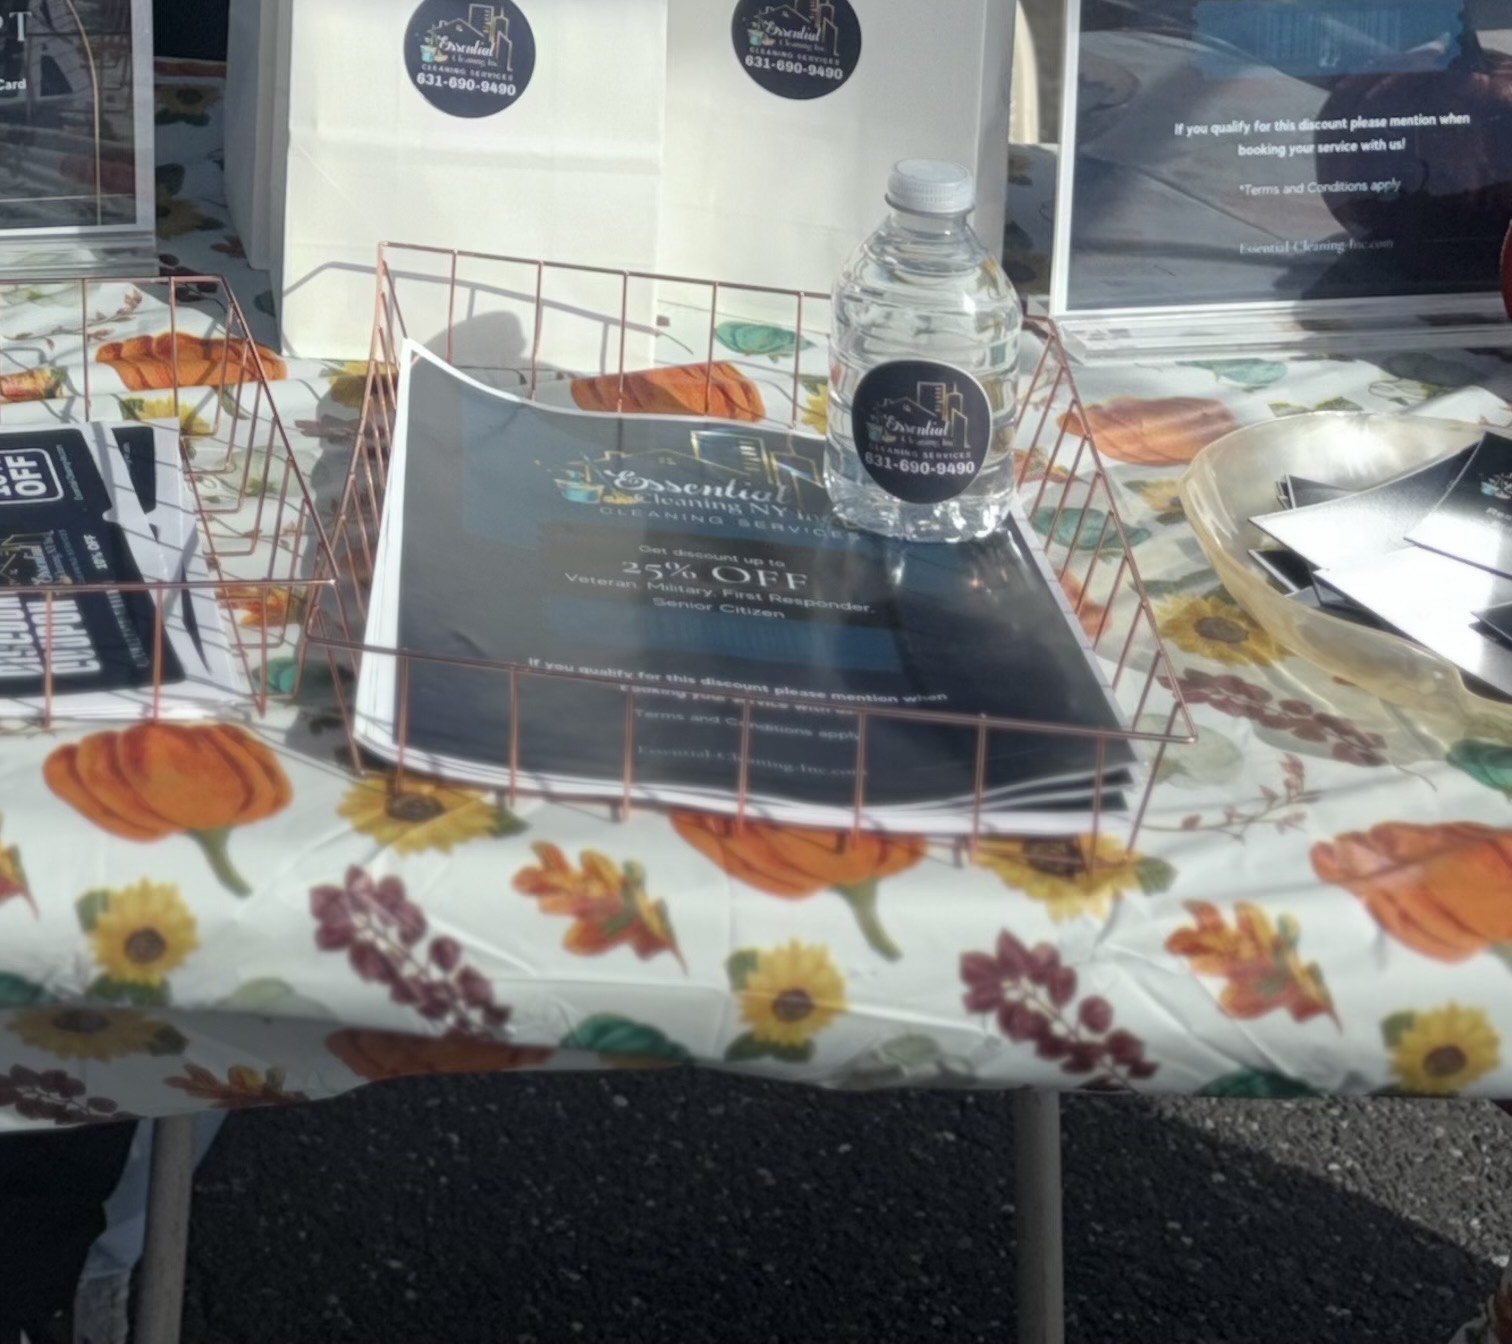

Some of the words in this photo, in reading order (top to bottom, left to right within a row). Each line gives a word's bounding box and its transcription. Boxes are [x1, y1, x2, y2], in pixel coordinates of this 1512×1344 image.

[745, 54, 843, 79] 631-690-9490
[417, 72, 516, 96] 631-690-9490
[1174, 123, 1184, 135] If
[1186, 124, 1208, 138] you
[1211, 120, 1250, 136] qualify
[1254, 120, 1272, 133] for
[1274, 119, 1295, 132] this
[1298, 117, 1348, 131] discount
[1350, 115, 1387, 132] please
[1390, 113, 1437, 127] mention
[1439, 112, 1470, 125] when
[1238, 143, 1286, 158] booking
[1288, 143, 1315, 158] your
[1318, 141, 1358, 153] service
[1361, 138, 1386, 151] with
[1389, 138, 1406, 151] us!
[1283, 182, 1304, 194] and
[1307, 180, 1368, 193] Conditions
[1370, 178, 1401, 193] apply
[865, 451, 975, 475] 631-690-9490
[6, 454, 48, 498] OFF
[603, 469, 792, 503] Essential
[599, 506, 725, 525] CLEANING
[750, 501, 788, 518] NY
[83, 534, 101, 551] OFF
[639, 543, 667, 555] Get
[672, 548, 738, 563] discount
[743, 556, 764, 566] up
[767, 558, 786, 568] to
[621, 560, 698, 580] 25%
[711, 564, 808, 591] OFF
[722, 587, 763, 603] First
[652, 597, 713, 612] Senior
[719, 603, 785, 619] Citizen
[529, 657, 541, 667] If
[545, 661, 575, 672] you
[578, 665, 634, 680] qualify
[637, 671, 662, 681] for
[666, 673, 696, 685] this
[700, 676, 770, 693] discount
[774, 686, 826, 700] please
[830, 690, 898, 705] mention
[902, 690, 948, 703] when
[690, 714, 721, 726] and
[725, 716, 813, 738] Cnditions
